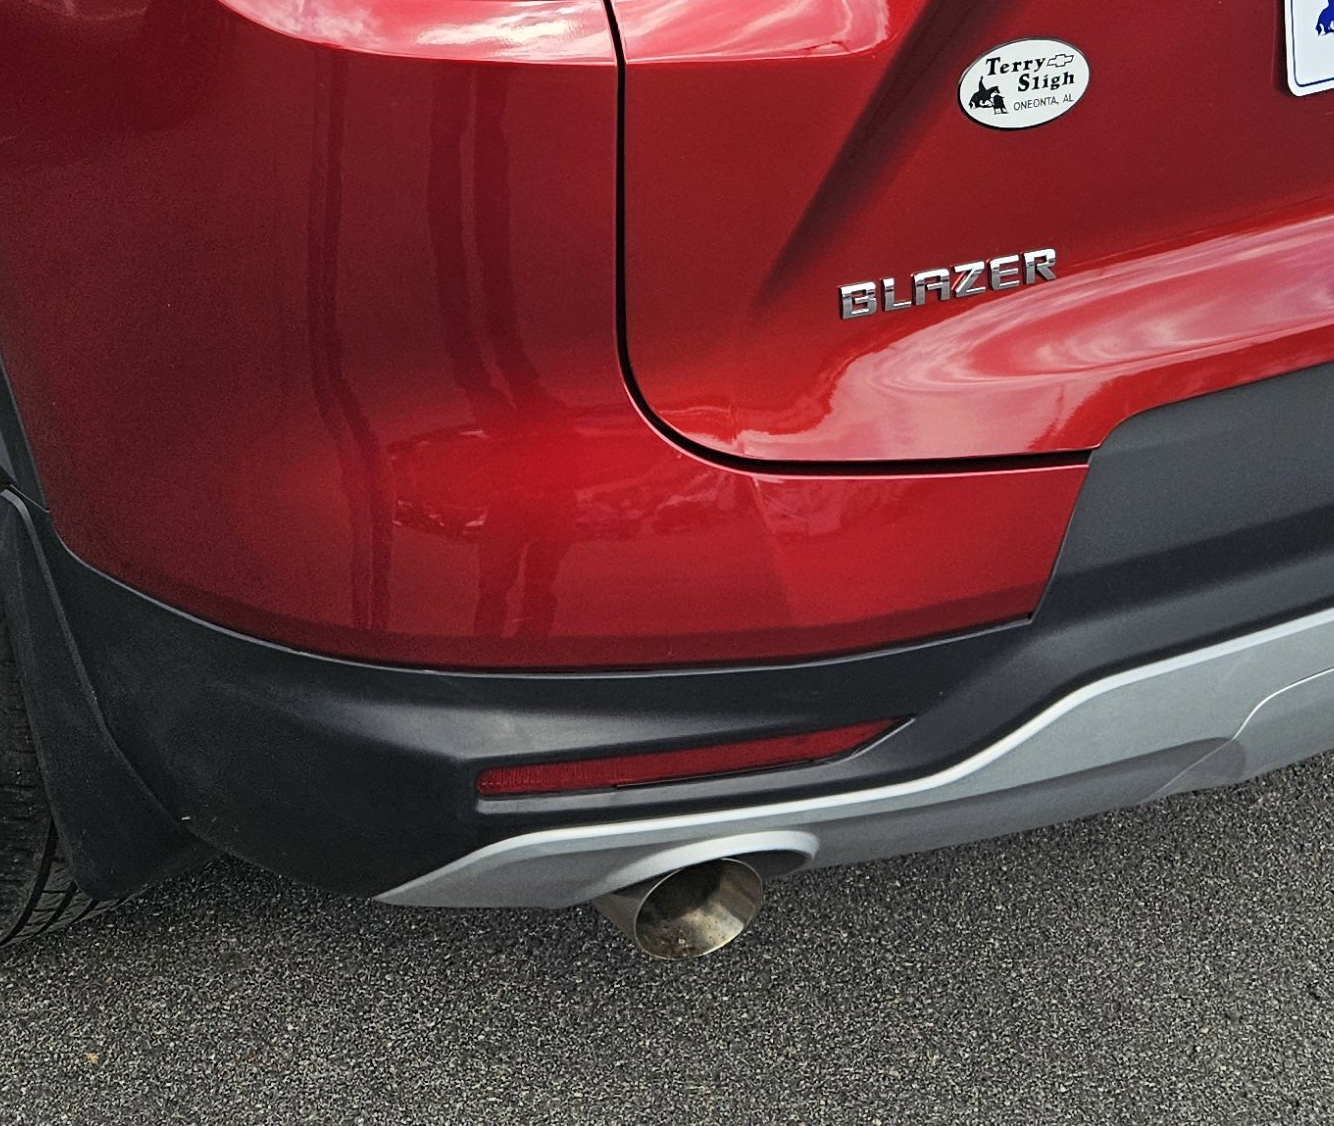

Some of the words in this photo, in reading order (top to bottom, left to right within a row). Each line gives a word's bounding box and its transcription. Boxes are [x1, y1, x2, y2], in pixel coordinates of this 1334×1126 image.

[985, 56, 1046, 76] Terry
[1017, 72, 1075, 92] Sligh
[1013, 97, 1059, 112] ONEONTA,
[1062, 94, 1074, 102] AL
[839, 248, 1057, 320] BLAZER
